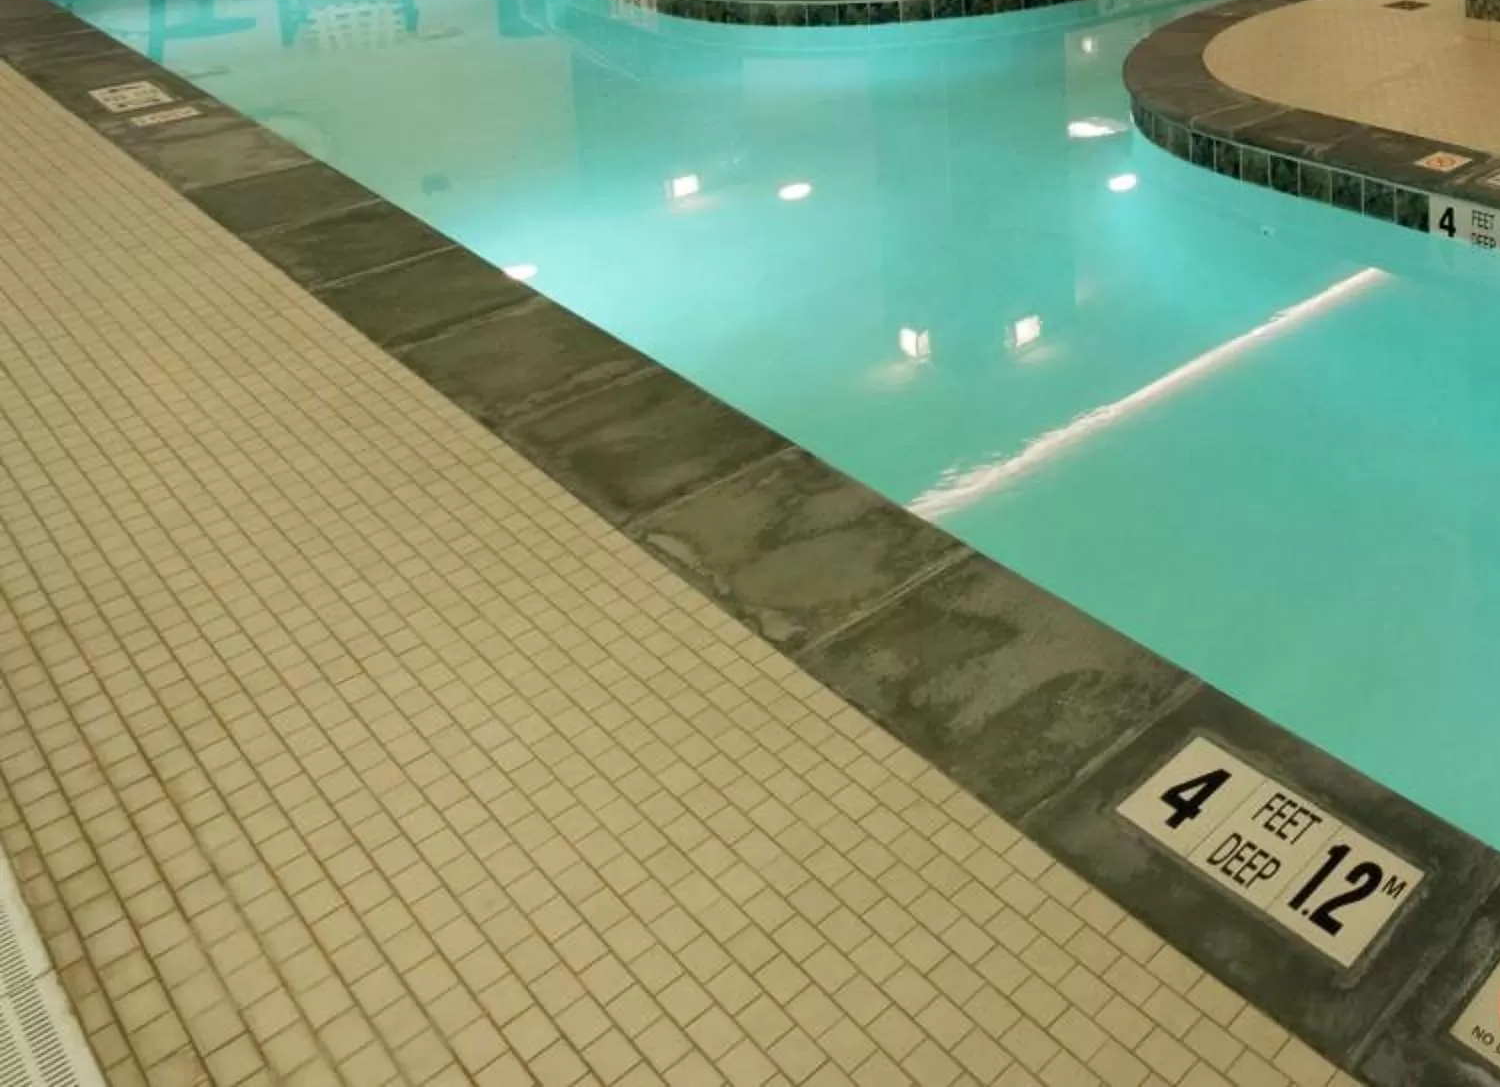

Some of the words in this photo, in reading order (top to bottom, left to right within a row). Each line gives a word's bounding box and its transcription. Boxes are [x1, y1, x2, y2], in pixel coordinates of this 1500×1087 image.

[1439, 206, 1457, 238] 4
[1471, 209, 1496, 230] FEET
[1160, 768, 1233, 830] 4
[1251, 792, 1324, 846] FEET
[1206, 832, 1283, 890] DEEP
[1287, 843, 1384, 937] 1.2
[1471, 1024, 1495, 1046] NO
